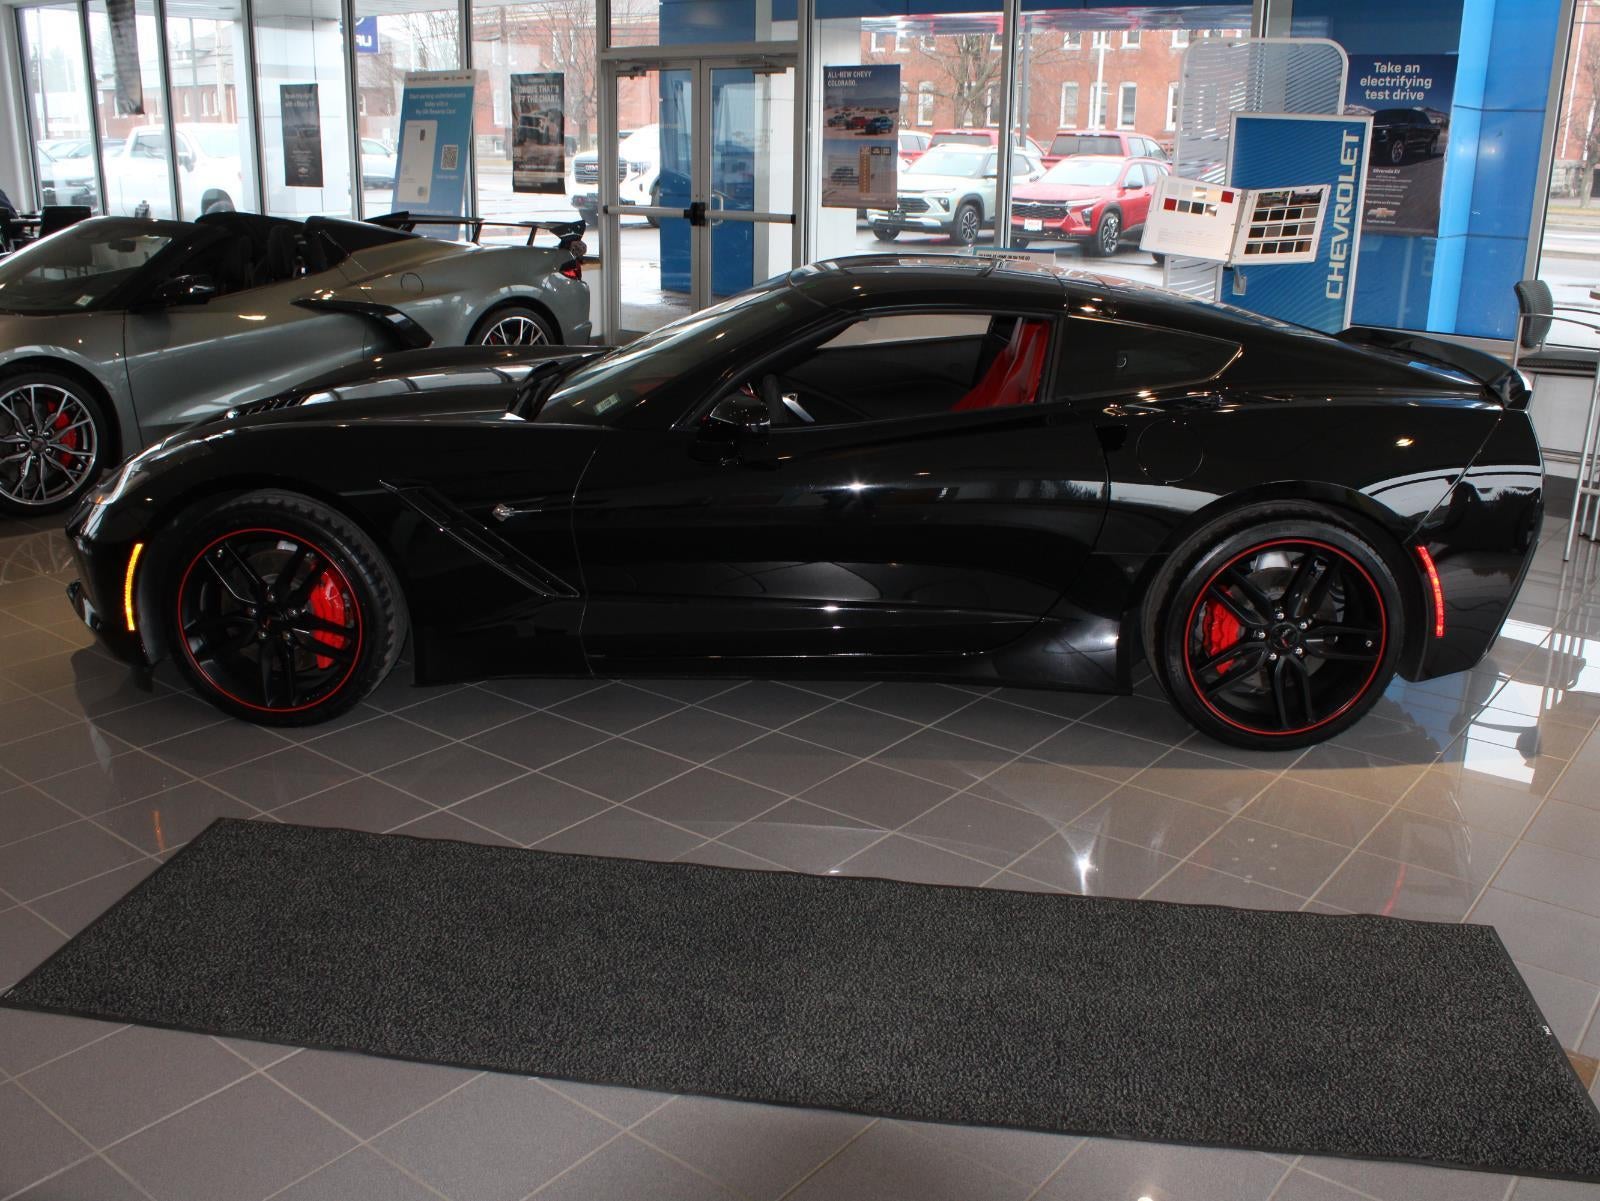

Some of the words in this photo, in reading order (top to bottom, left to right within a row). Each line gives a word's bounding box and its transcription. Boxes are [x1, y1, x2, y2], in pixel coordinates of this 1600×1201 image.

[1373, 61, 1402, 73] Take
[1404, 64, 1420, 73] an
[827, 71, 852, 79] ALL-NEW
[853, 70, 872, 78] CHEVY
[1360, 75, 1433, 89] electrifying
[1365, 89, 1391, 100] test
[1392, 89, 1425, 100] drive
[1325, 129, 1360, 299] CHEVROLET
